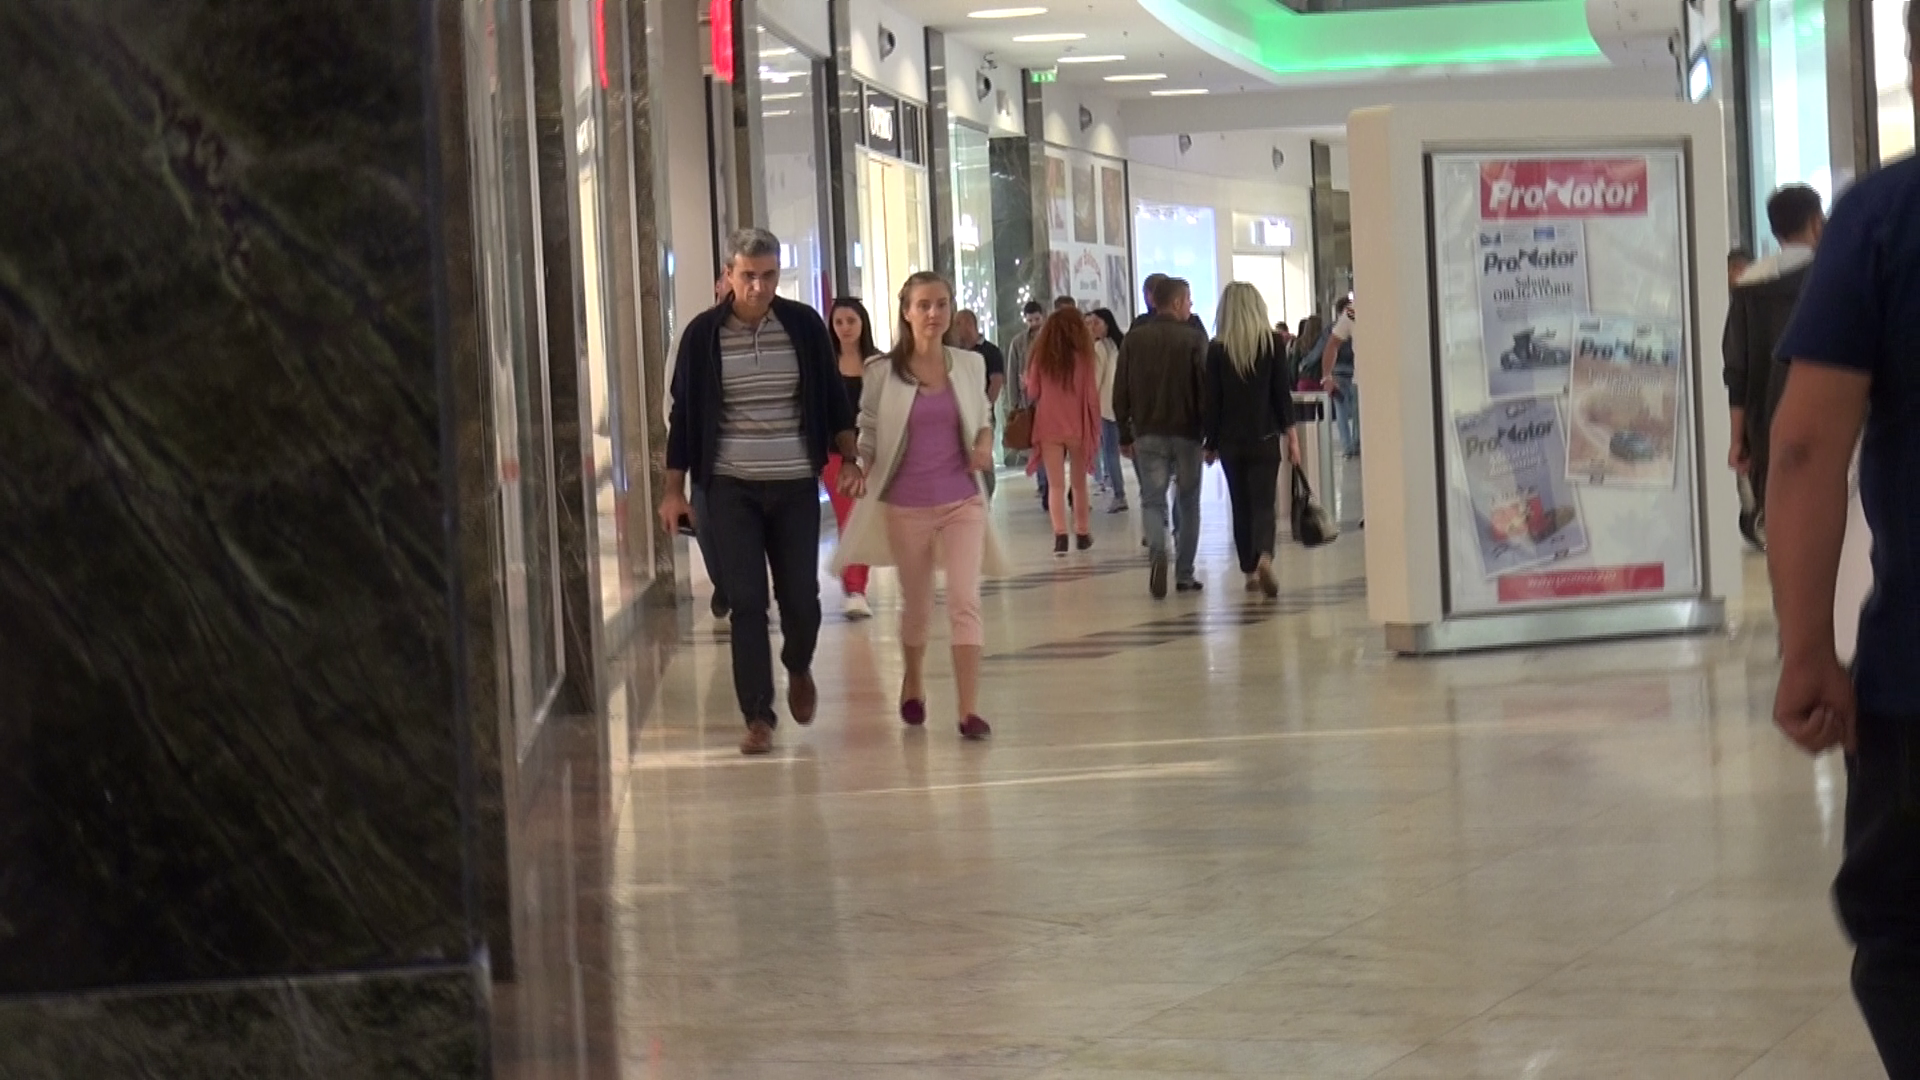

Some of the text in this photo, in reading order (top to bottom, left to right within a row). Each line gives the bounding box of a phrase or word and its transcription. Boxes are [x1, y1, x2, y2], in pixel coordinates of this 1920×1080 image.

[1488, 176, 1640, 210] ProMotor
[1484, 246, 1578, 275] ProMotor
[1466, 420, 1555, 457] ProMotor
